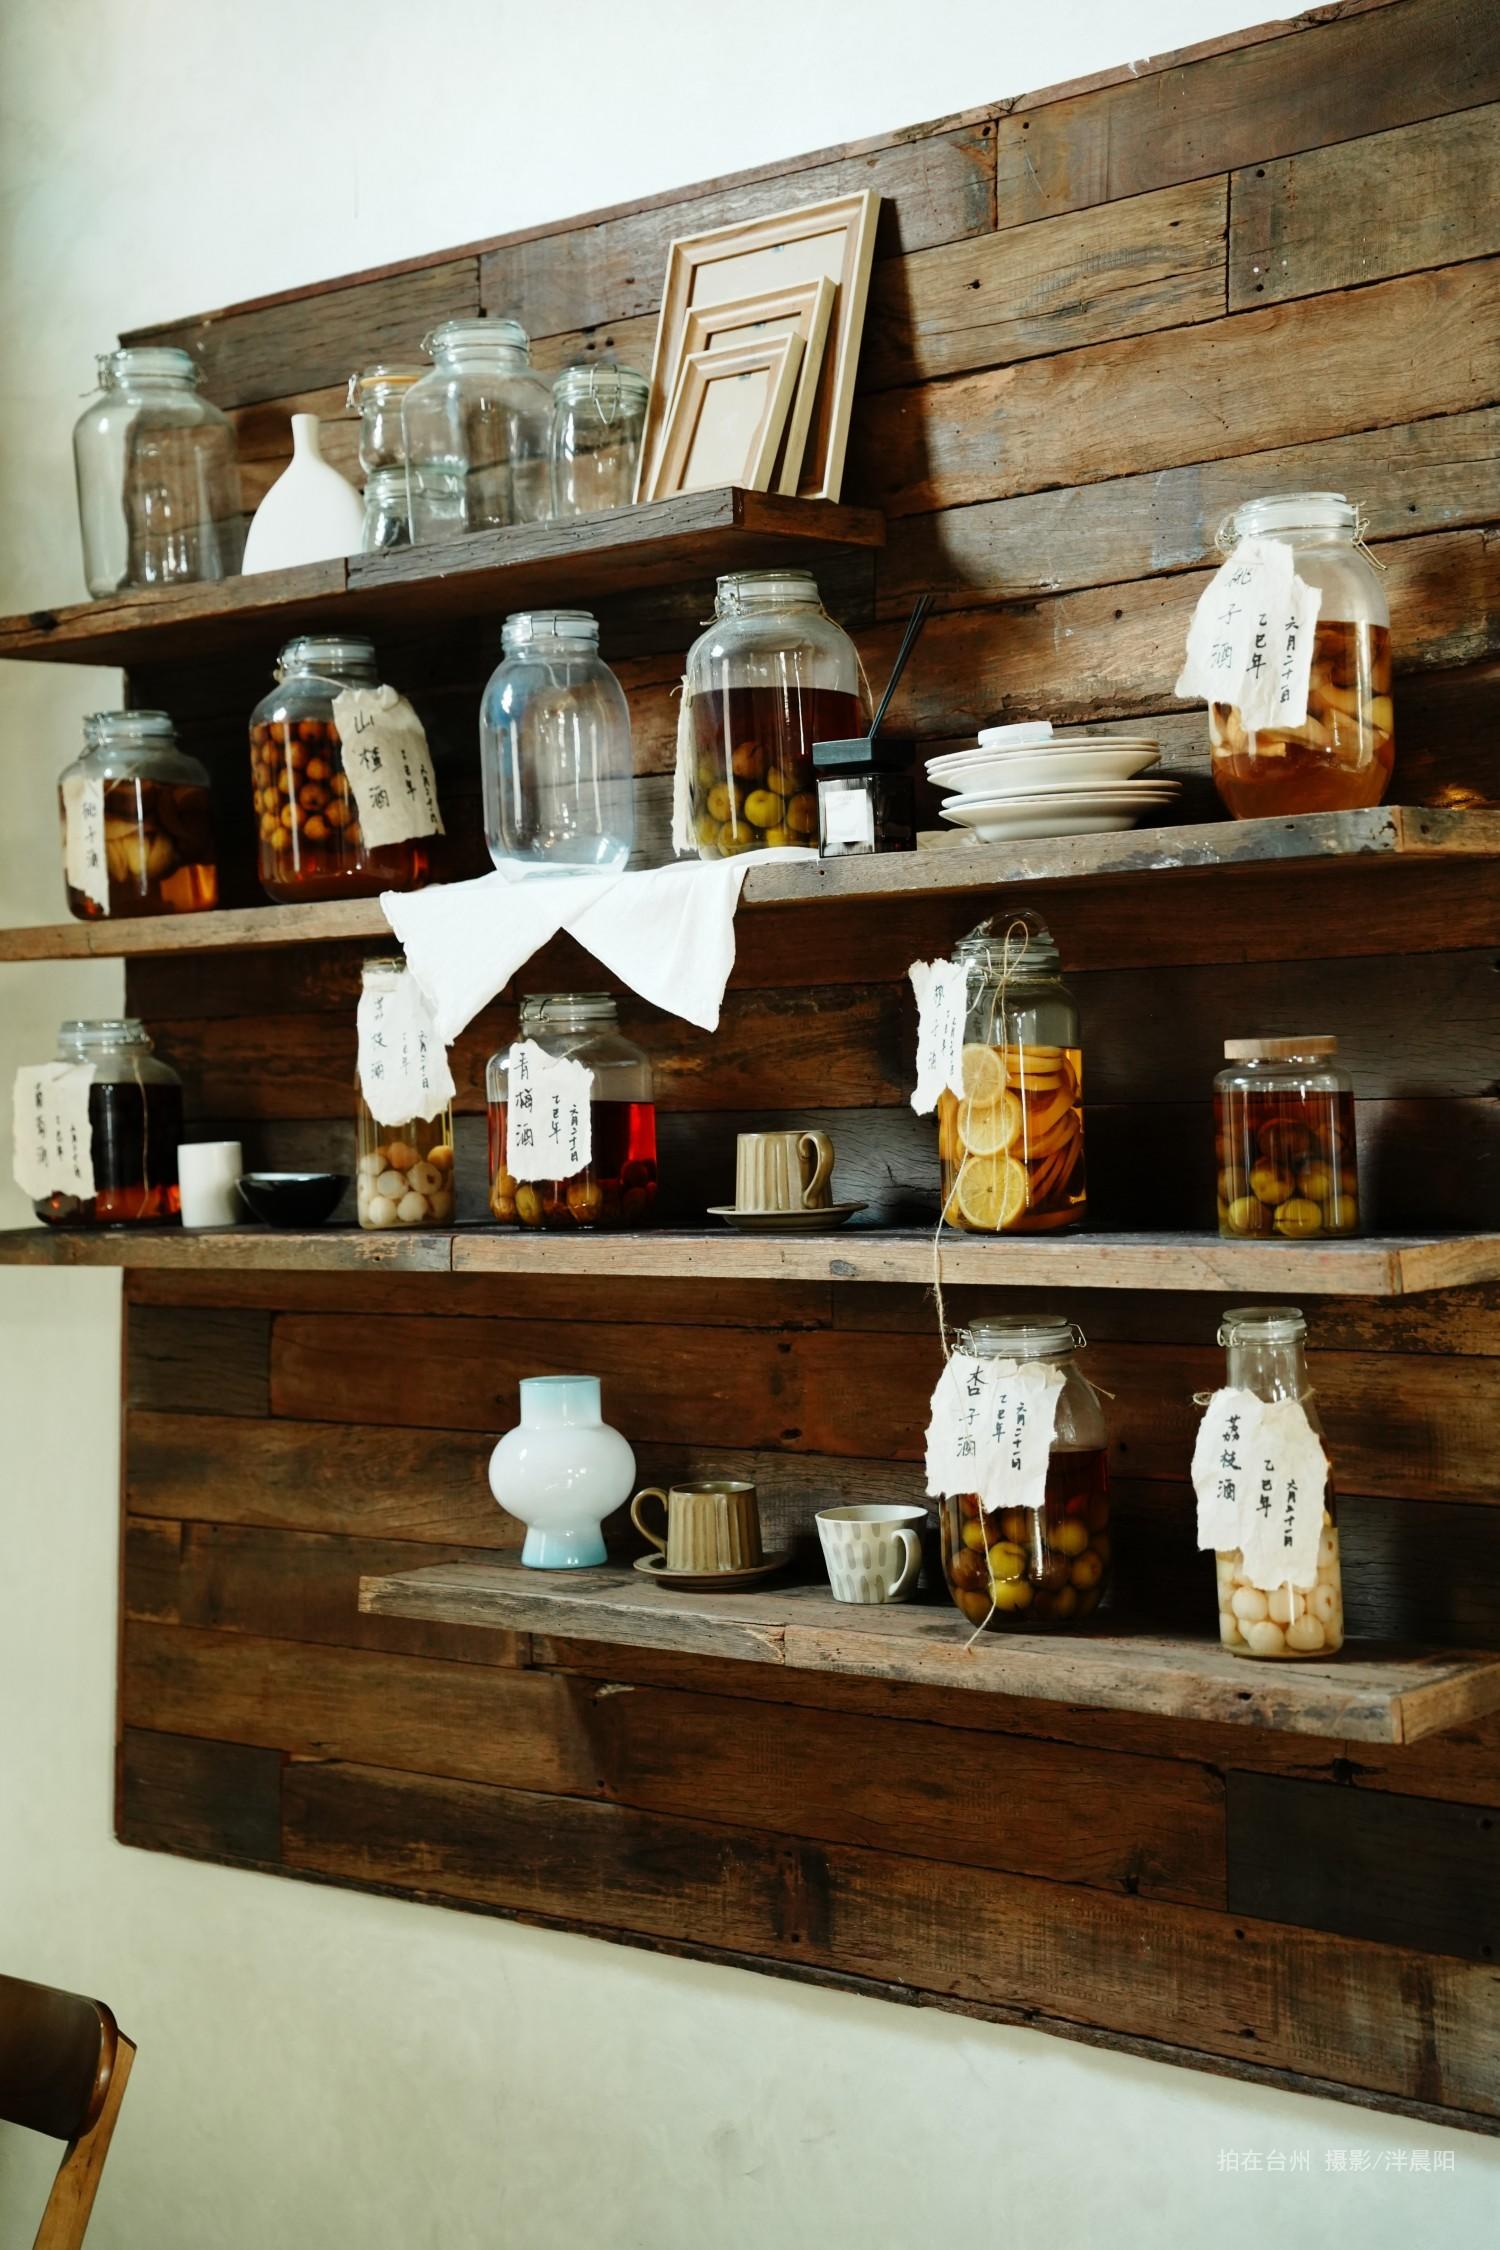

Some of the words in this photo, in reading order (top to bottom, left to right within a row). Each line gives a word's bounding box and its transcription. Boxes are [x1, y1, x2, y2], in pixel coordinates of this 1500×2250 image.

[1246, 613, 1267, 679] 乙巳年
[1278, 616, 1300, 704] 六月二十一日
[353, 710, 391, 809] 山楂酒
[513, 1052, 535, 1147] 青梅酒
[548, 1095, 561, 1144] 乙巳年
[956, 1365, 988, 1457] 杏子酒
[992, 1394, 1008, 1443] 乙巳年
[1011, 1402, 1028, 1471] 六月二十一日
[1216, 1413, 1242, 1502] 荔枝酒
[1256, 1459, 1275, 1518] 乙巳年
[1283, 1478, 1298, 1548] 六月二十一日
